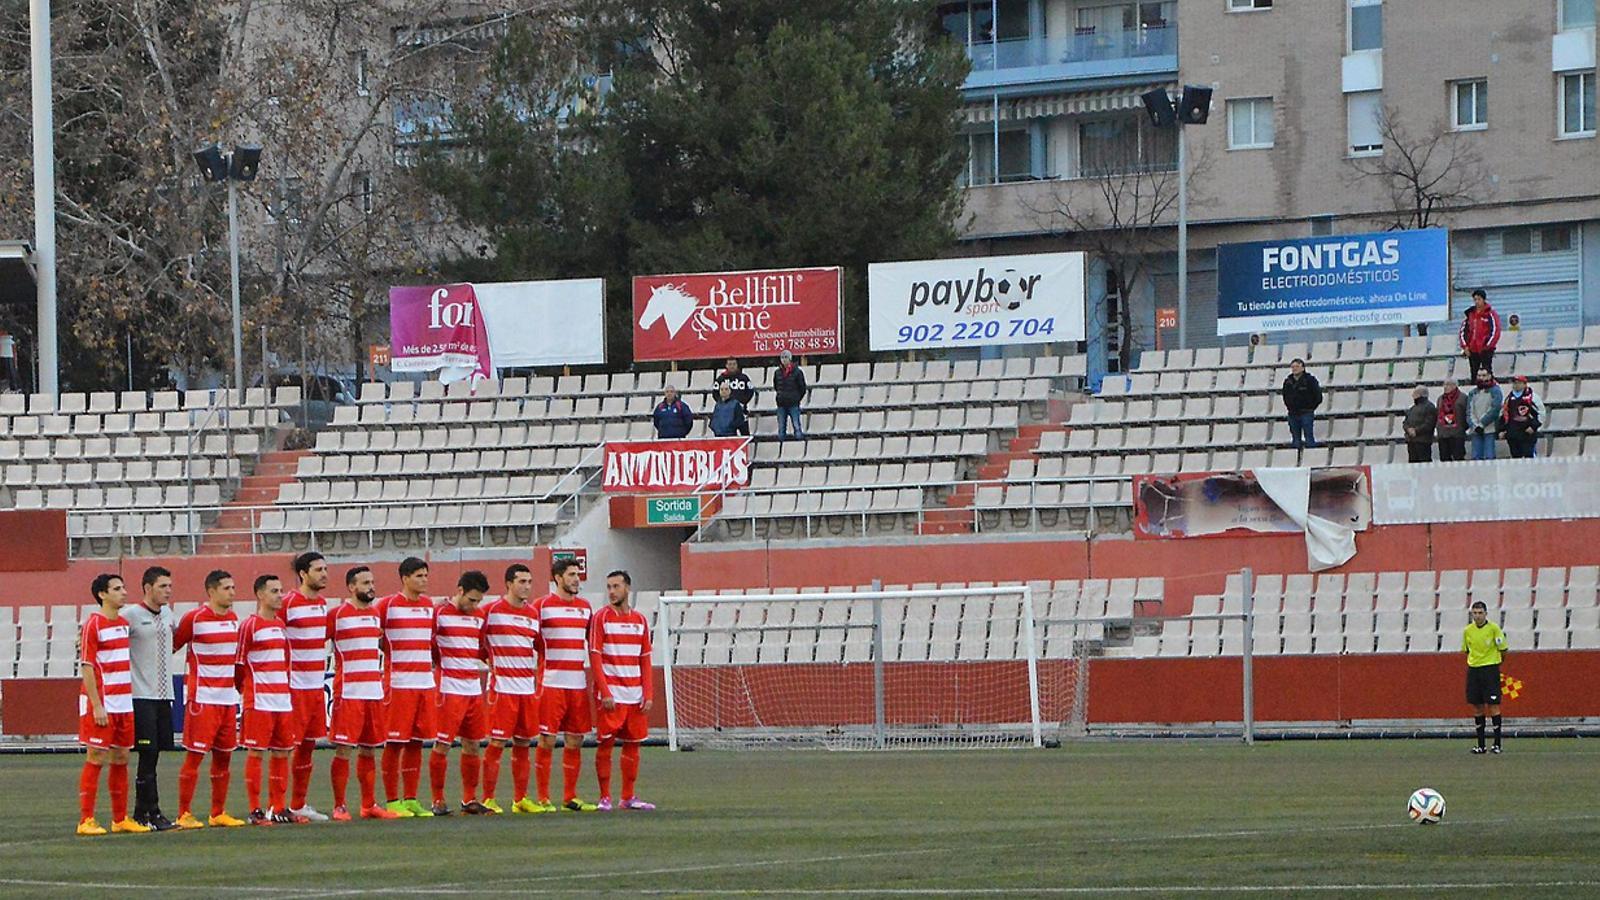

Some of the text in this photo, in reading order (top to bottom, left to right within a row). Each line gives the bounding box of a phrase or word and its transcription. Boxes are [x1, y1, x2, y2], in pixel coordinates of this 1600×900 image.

[1262, 239, 1400, 273] FONTGAS
[1262, 268, 1400, 290] ELECTRODOMÉSTICOS
[966, 302, 999, 317] sport
[1237, 302, 1248, 312] Tu
[1249, 300, 1275, 311] tienda
[1277, 300, 1288, 310] de
[1289, 294, 1367, 309] electrodomésticos,
[1369, 293, 1393, 304] ahora
[1394, 292, 1407, 302] On
[1160, 318, 1175, 327] 210
[1262, 312, 1403, 328] www.electrodomesticosfg.com
[789, 327, 835, 338] Immobiliaris
[897, 317, 1055, 344] 902 220 704
[402, 345, 419, 355] Més
[420, 344, 432, 354] de
[753, 337, 835, 351] Tel. 93 788 48 59
[373, 354, 388, 364] 211
[603, 449, 748, 487] ANTINIEBLAS
[1432, 479, 1563, 503] tmesa.com
[656, 499, 692, 512] Sortida
